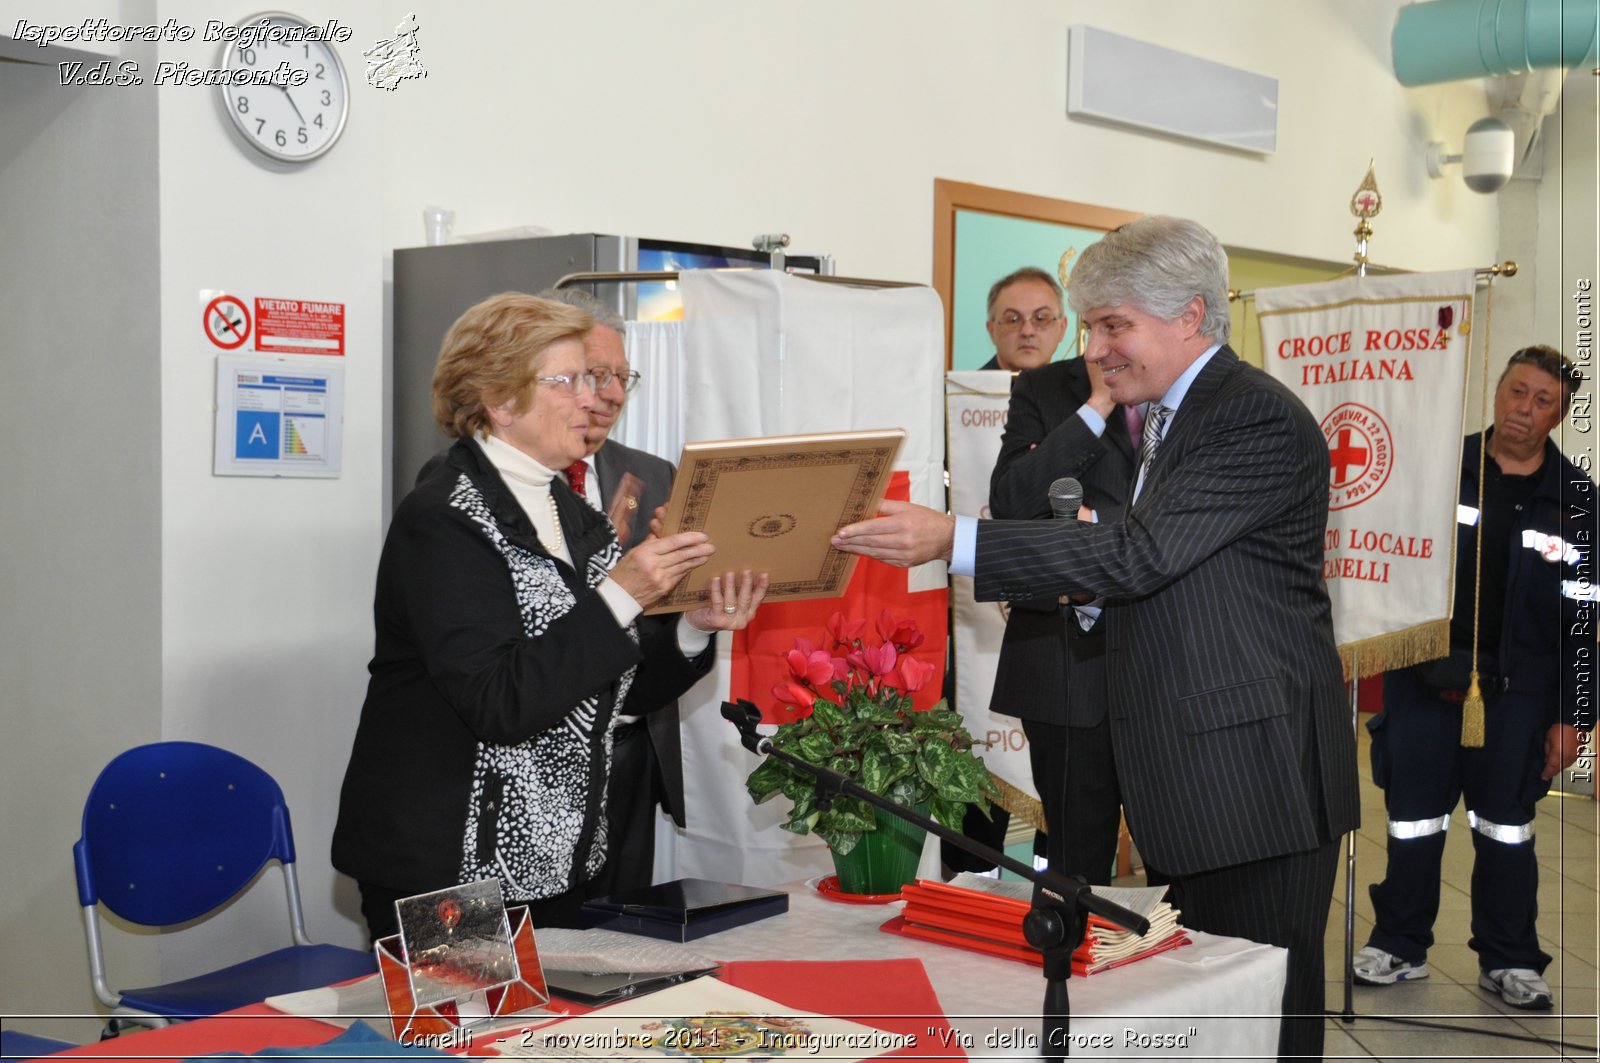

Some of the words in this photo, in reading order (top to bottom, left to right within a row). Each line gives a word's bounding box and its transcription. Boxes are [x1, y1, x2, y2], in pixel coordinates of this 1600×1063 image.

[237, 48, 256, 66] 10
[303, 42, 310, 59] 1
[314, 62, 325, 80] 2
[236, 96, 249, 114] 8
[320, 90, 331, 107] 3
[254, 117, 267, 135] 7
[313, 113, 323, 130] 4
[275, 130, 287, 147] 6
[297, 127, 309, 144] 5
[258, 299, 298, 312] VIETATO
[302, 302, 342, 315] FUMARE
[1278, 331, 1352, 360] CROCE
[1364, 328, 1449, 351] ROSSA
[1302, 359, 1414, 386] ITALIANA
[247, 421, 268, 445] A
[1367, 422, 1381, 436] 22
[1370, 437, 1388, 481] AGOSTO
[1346, 481, 1372, 500] 1864
[1348, 528, 1433, 559] LOCALE
[1322, 557, 1391, 583] CANELLI
